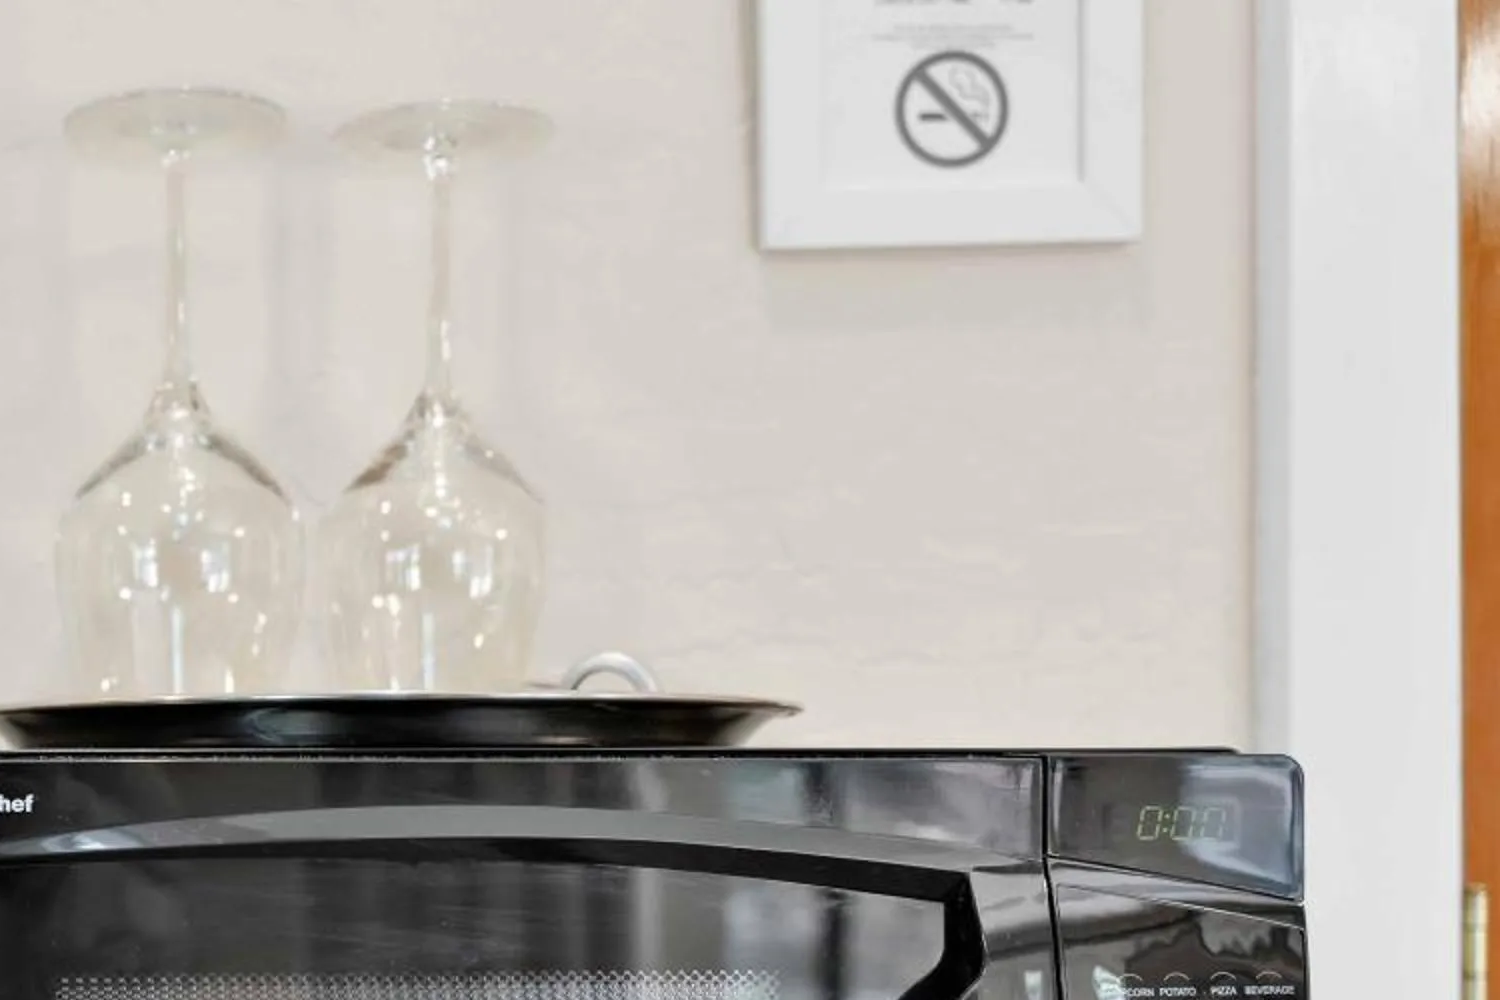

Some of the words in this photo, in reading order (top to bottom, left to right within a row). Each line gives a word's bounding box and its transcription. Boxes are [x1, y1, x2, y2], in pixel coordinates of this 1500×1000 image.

[1136, 806, 1227, 841] 0:00
[1159, 987, 1197, 997] POTATO
[1210, 986, 1237, 996] PIZZA
